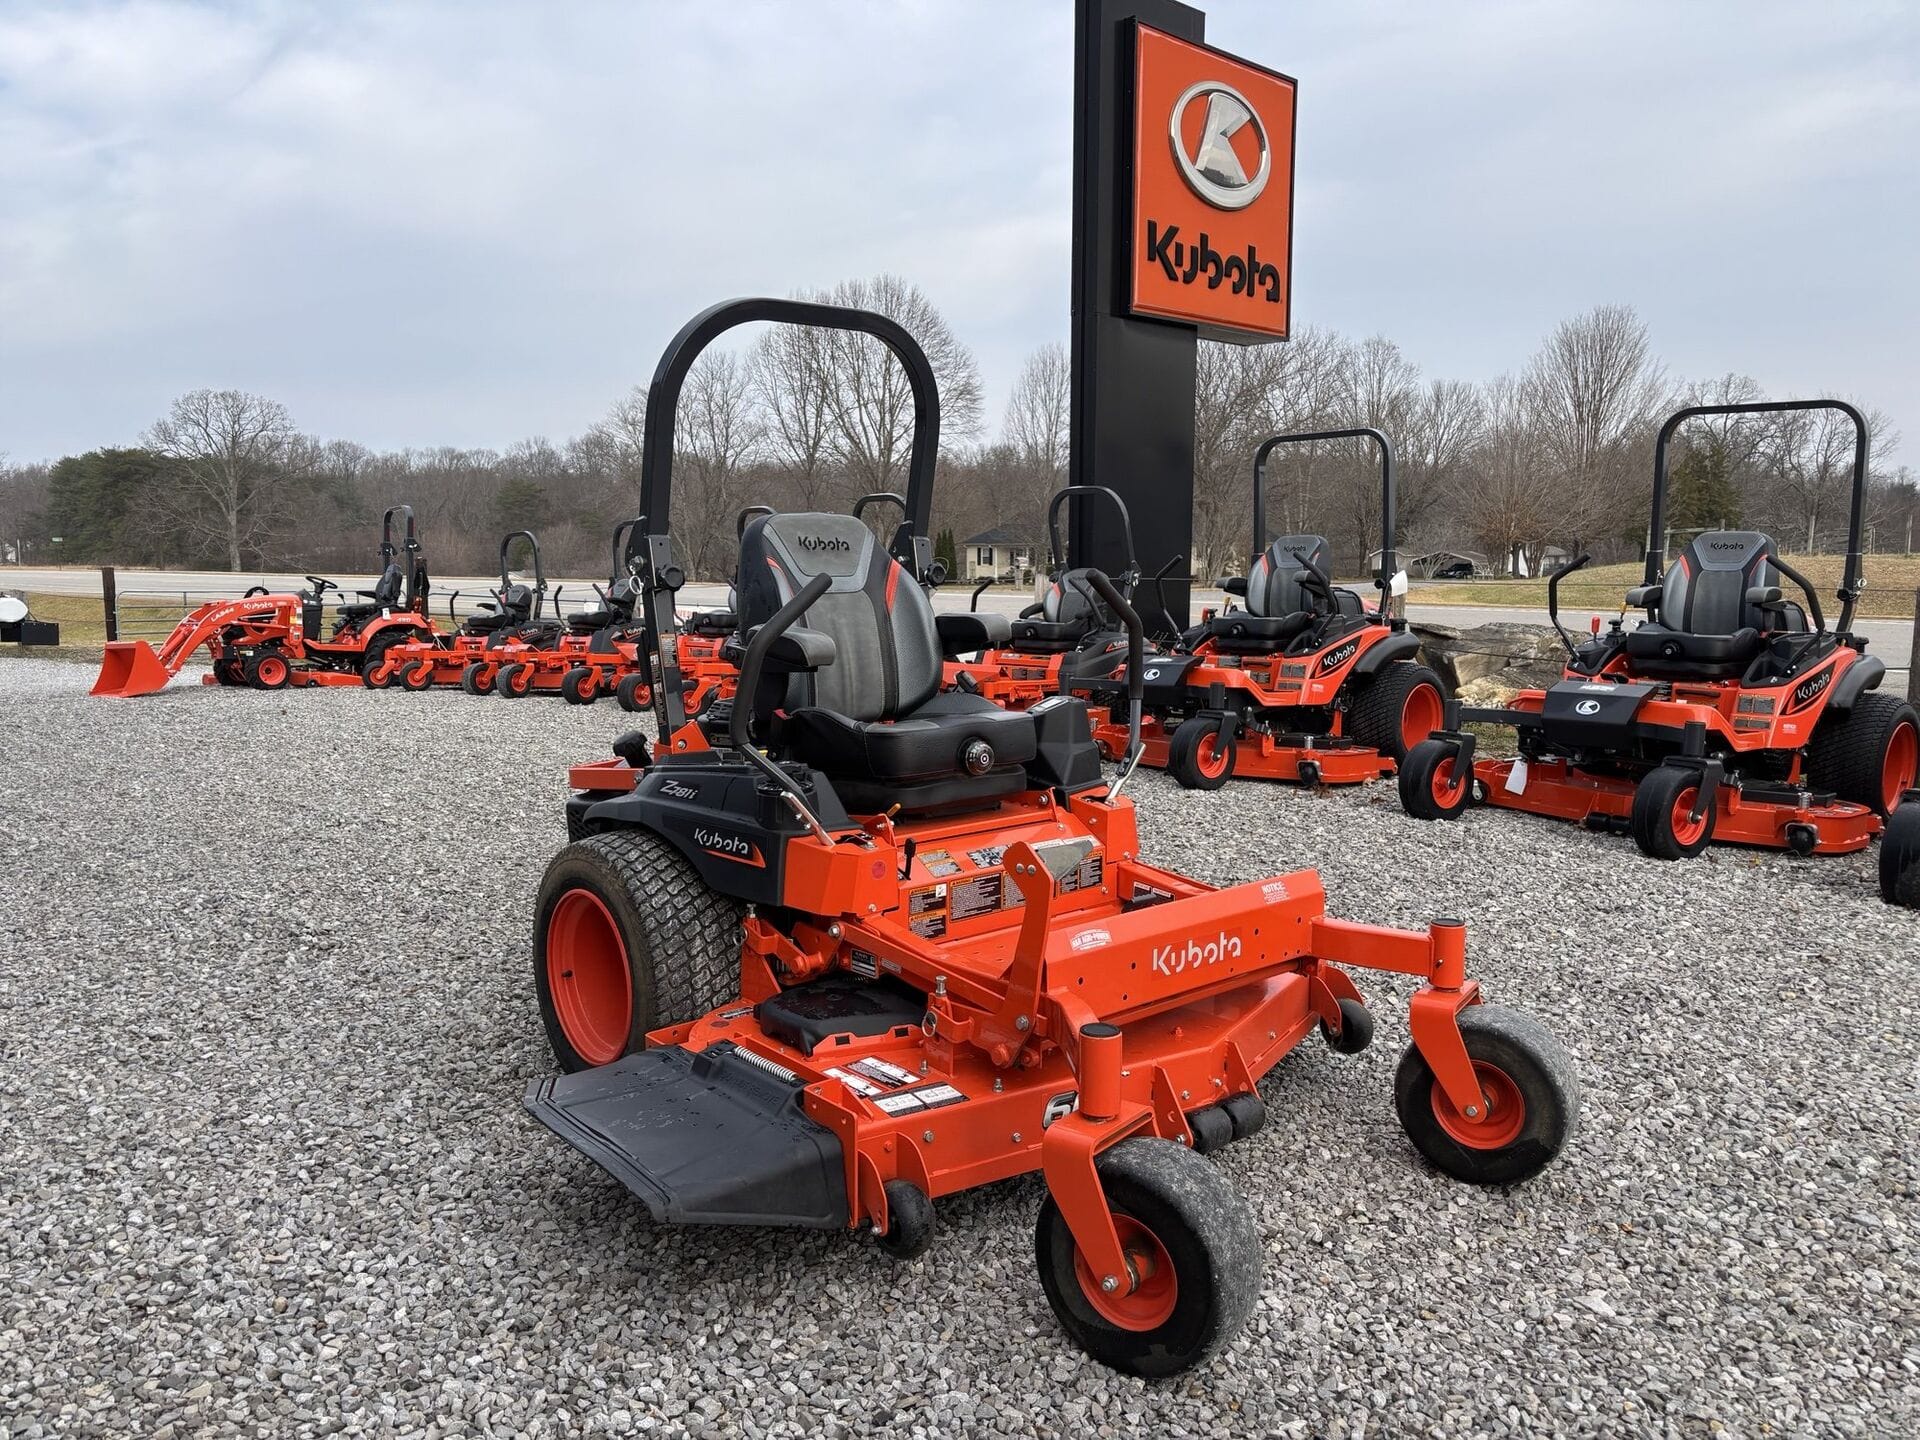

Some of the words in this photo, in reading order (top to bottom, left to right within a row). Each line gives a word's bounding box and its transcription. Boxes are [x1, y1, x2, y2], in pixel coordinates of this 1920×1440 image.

[1147, 219, 1281, 303] Kubota
[798, 536, 850, 551] Kubota
[1711, 542, 1744, 550] Kubota
[243, 601, 273, 610] Kubota
[1323, 644, 1356, 666] Kubota
[1797, 673, 1830, 699] Kubota
[660, 780, 698, 799] Z781i
[694, 828, 749, 854] Kubota
[1152, 931, 1242, 976] Kubota
